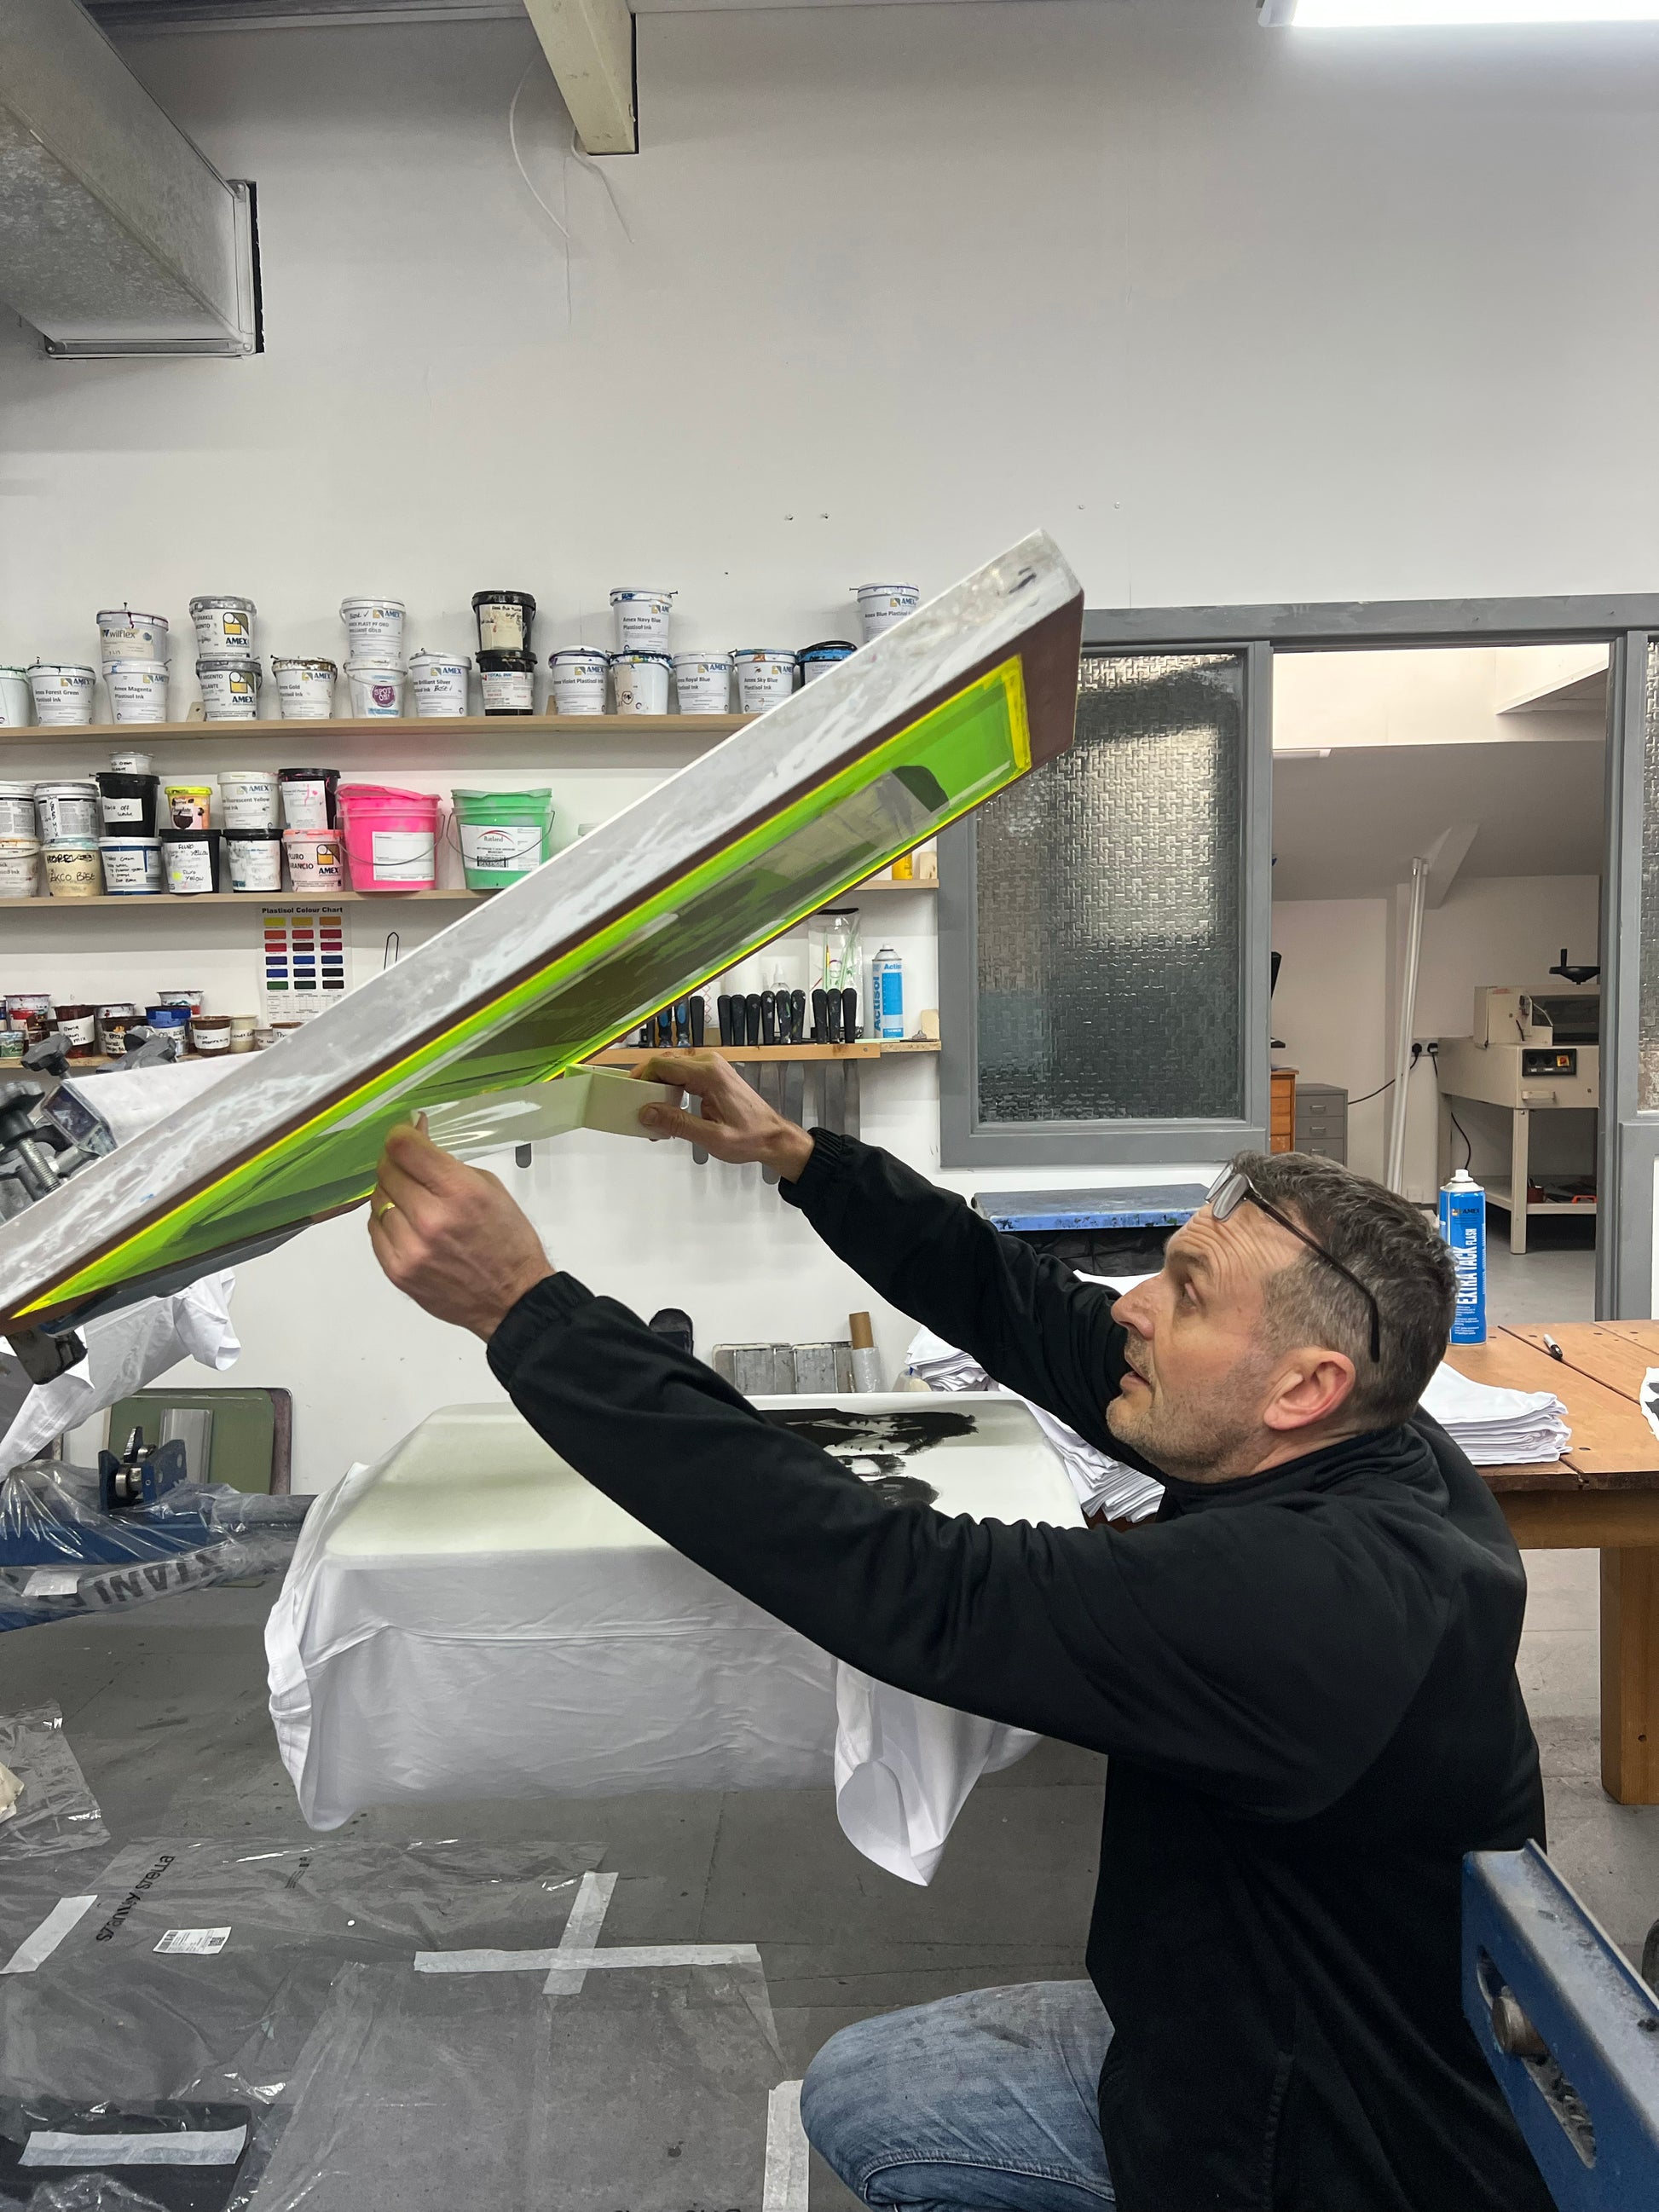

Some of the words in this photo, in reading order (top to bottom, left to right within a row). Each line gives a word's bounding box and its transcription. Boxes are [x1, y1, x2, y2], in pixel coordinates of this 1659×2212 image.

[873, 976, 882, 1031] Actisol
[1465, 1228, 1477, 1245] FLASH
[1452, 1246, 1477, 1271] TACK
[1454, 1273, 1477, 1304] EXTRA
